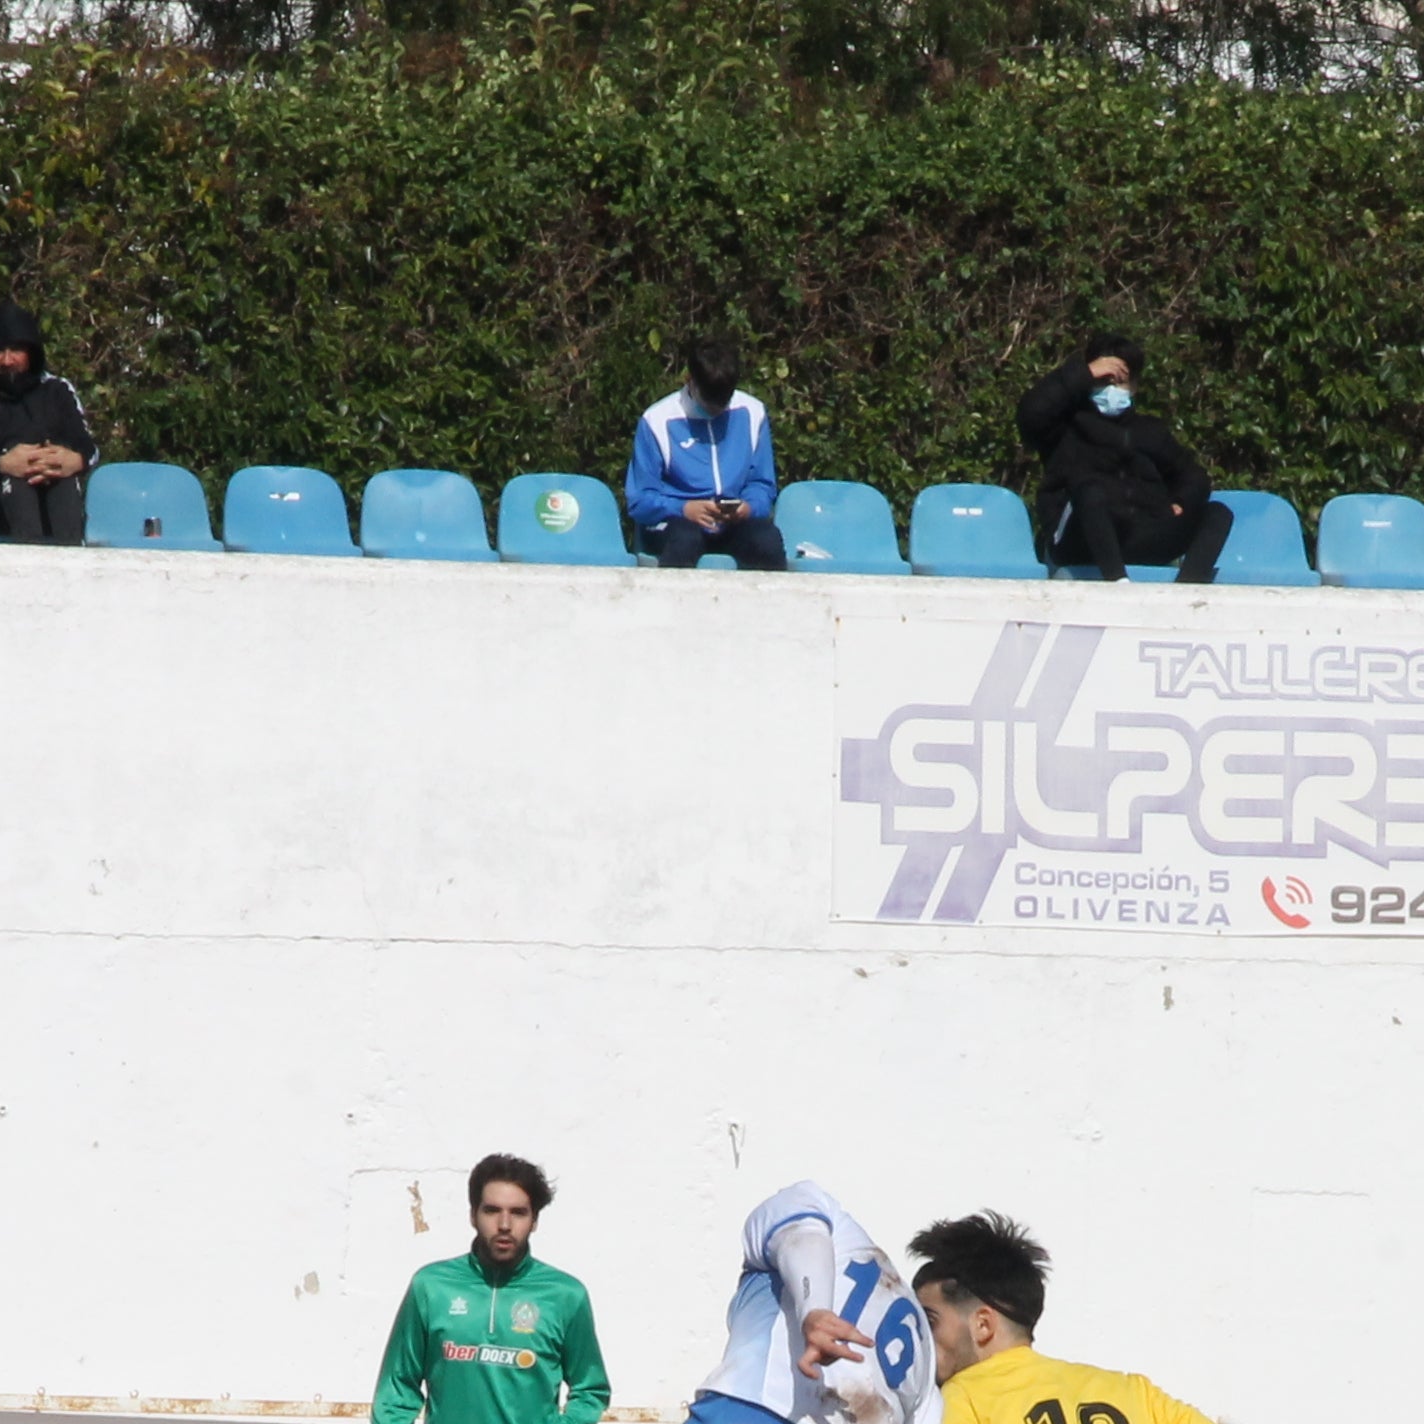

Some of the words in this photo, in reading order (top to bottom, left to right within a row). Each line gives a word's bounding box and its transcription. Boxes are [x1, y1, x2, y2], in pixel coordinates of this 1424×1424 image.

[1014, 862, 1199, 897] Concepción,
[1208, 870, 1230, 893] 5
[1013, 895, 1231, 926] OLIVENZA
[839, 1259, 923, 1389] 16
